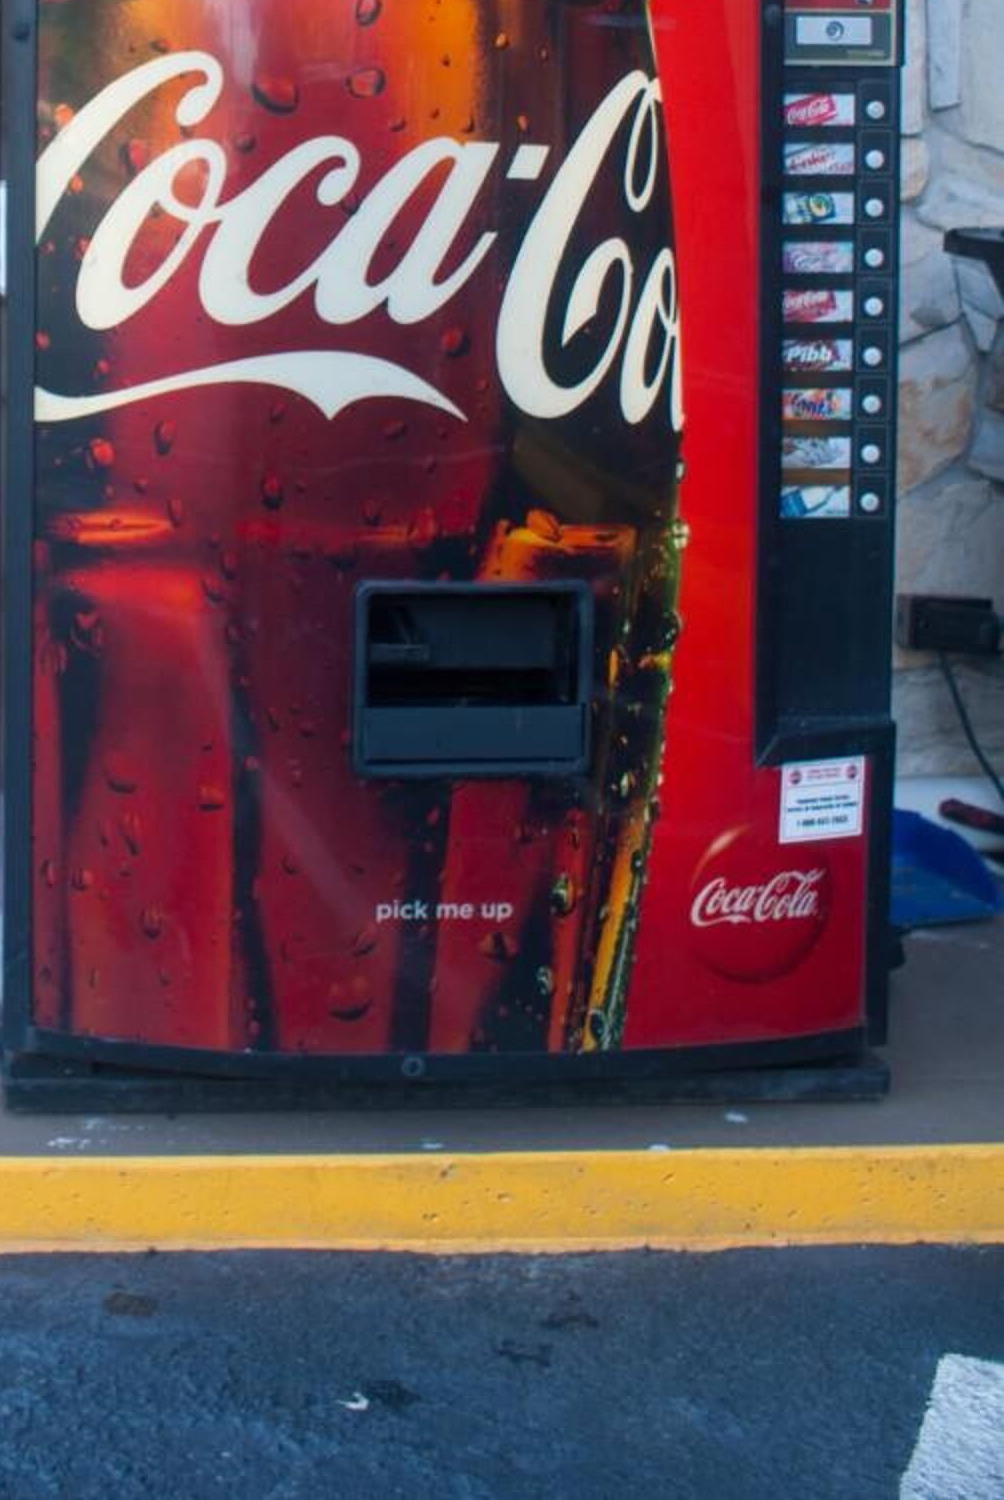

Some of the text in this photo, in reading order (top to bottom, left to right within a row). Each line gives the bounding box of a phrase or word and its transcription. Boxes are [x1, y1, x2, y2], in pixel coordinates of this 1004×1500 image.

[375, 900, 514, 923] pick me up
[691, 868, 826, 927] Coca-Cola
